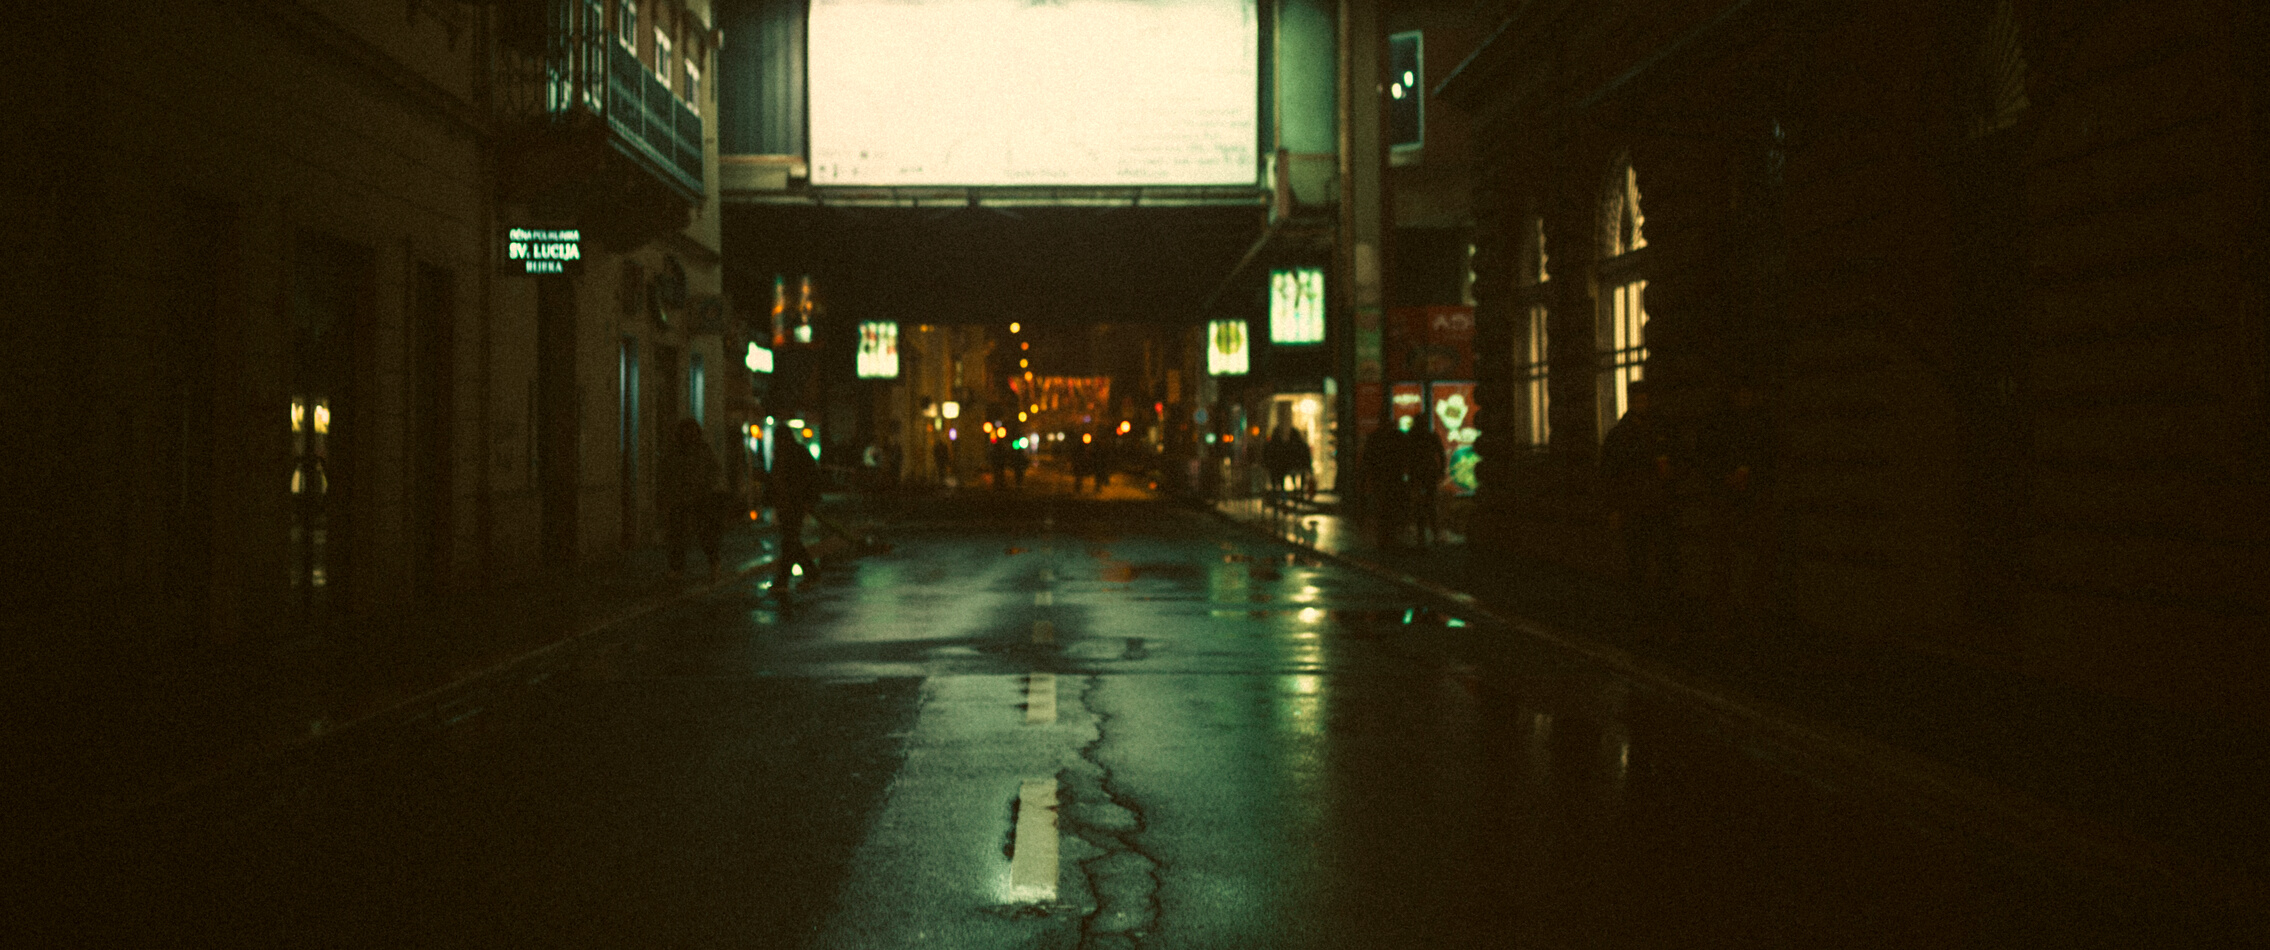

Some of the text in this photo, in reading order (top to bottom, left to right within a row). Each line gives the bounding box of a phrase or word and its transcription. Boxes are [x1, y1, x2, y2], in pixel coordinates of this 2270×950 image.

[509, 242, 580, 261] SV. LUCIJA
[525, 260, 563, 273] RIJEKA
